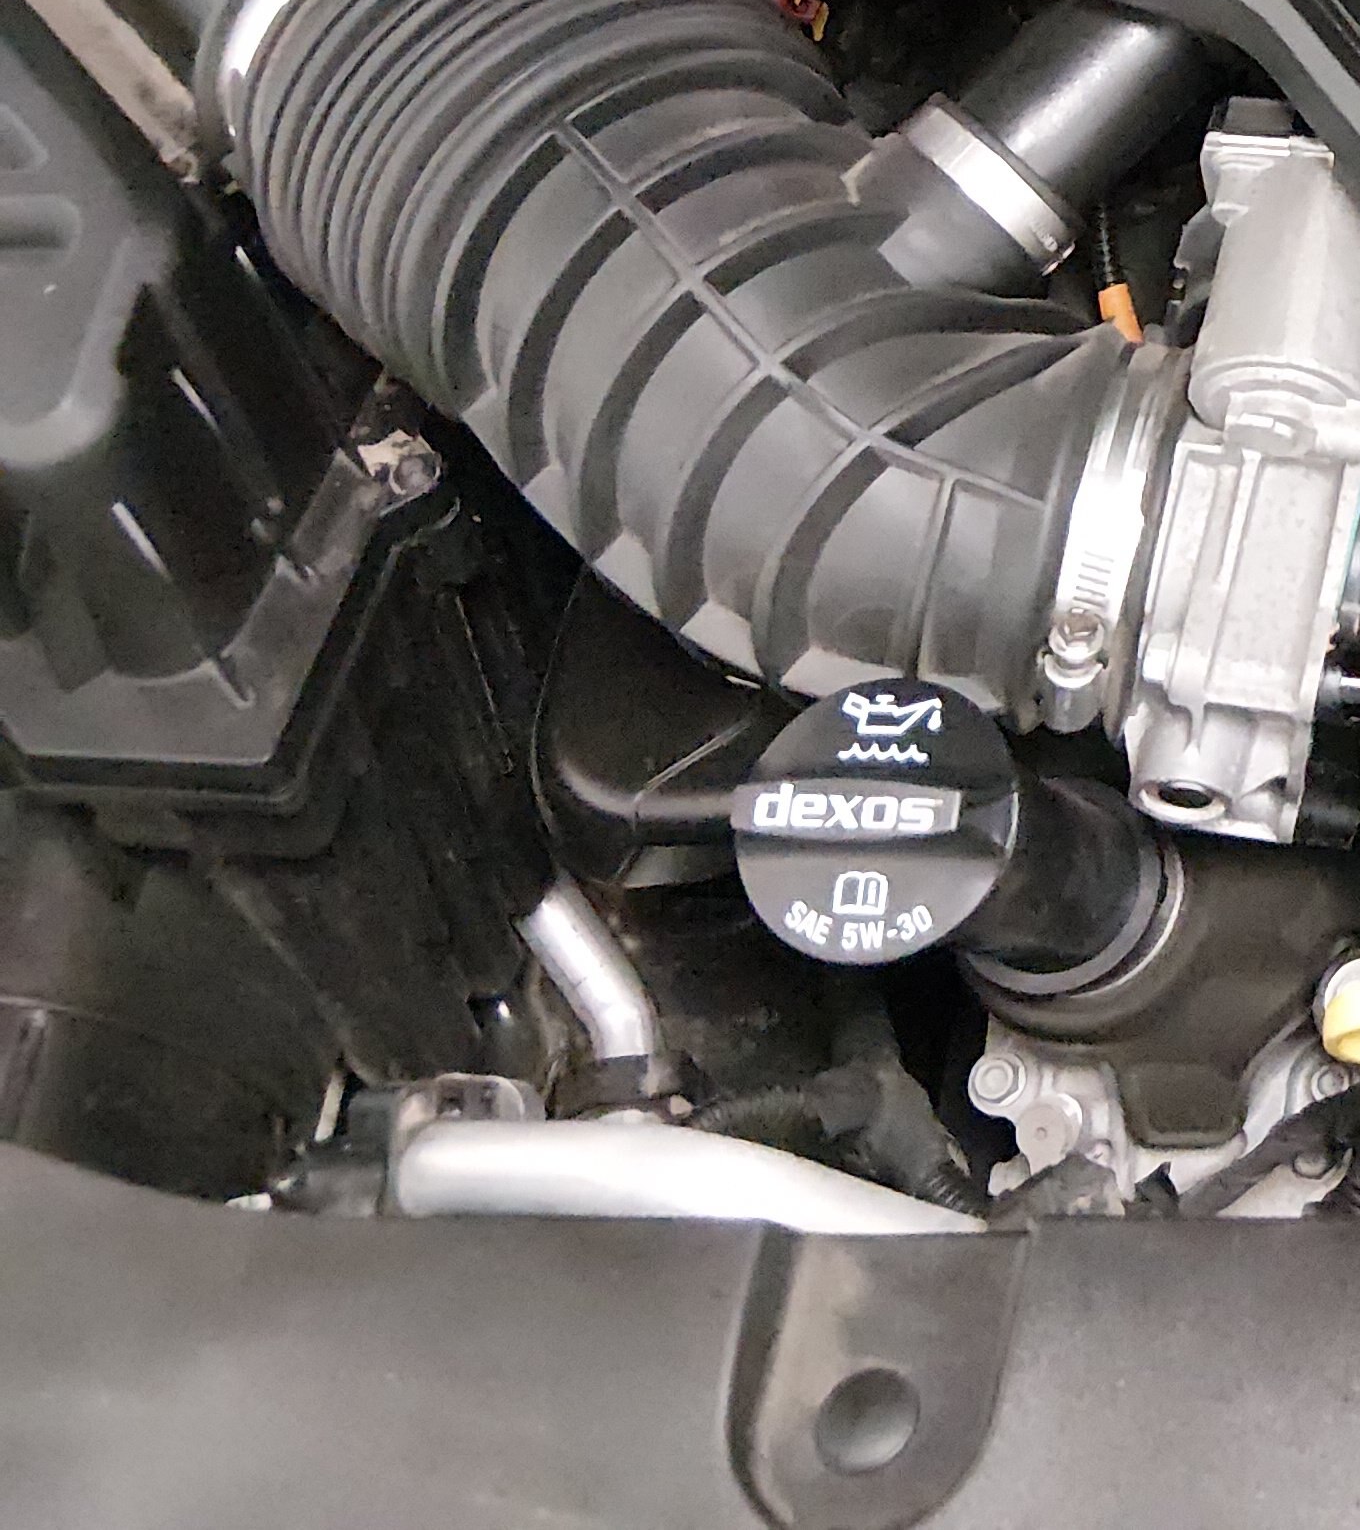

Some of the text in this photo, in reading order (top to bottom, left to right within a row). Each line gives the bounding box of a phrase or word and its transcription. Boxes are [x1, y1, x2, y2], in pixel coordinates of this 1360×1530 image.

[753, 782, 943, 832] dexos
[784, 900, 933, 950] SAE 5W-30
